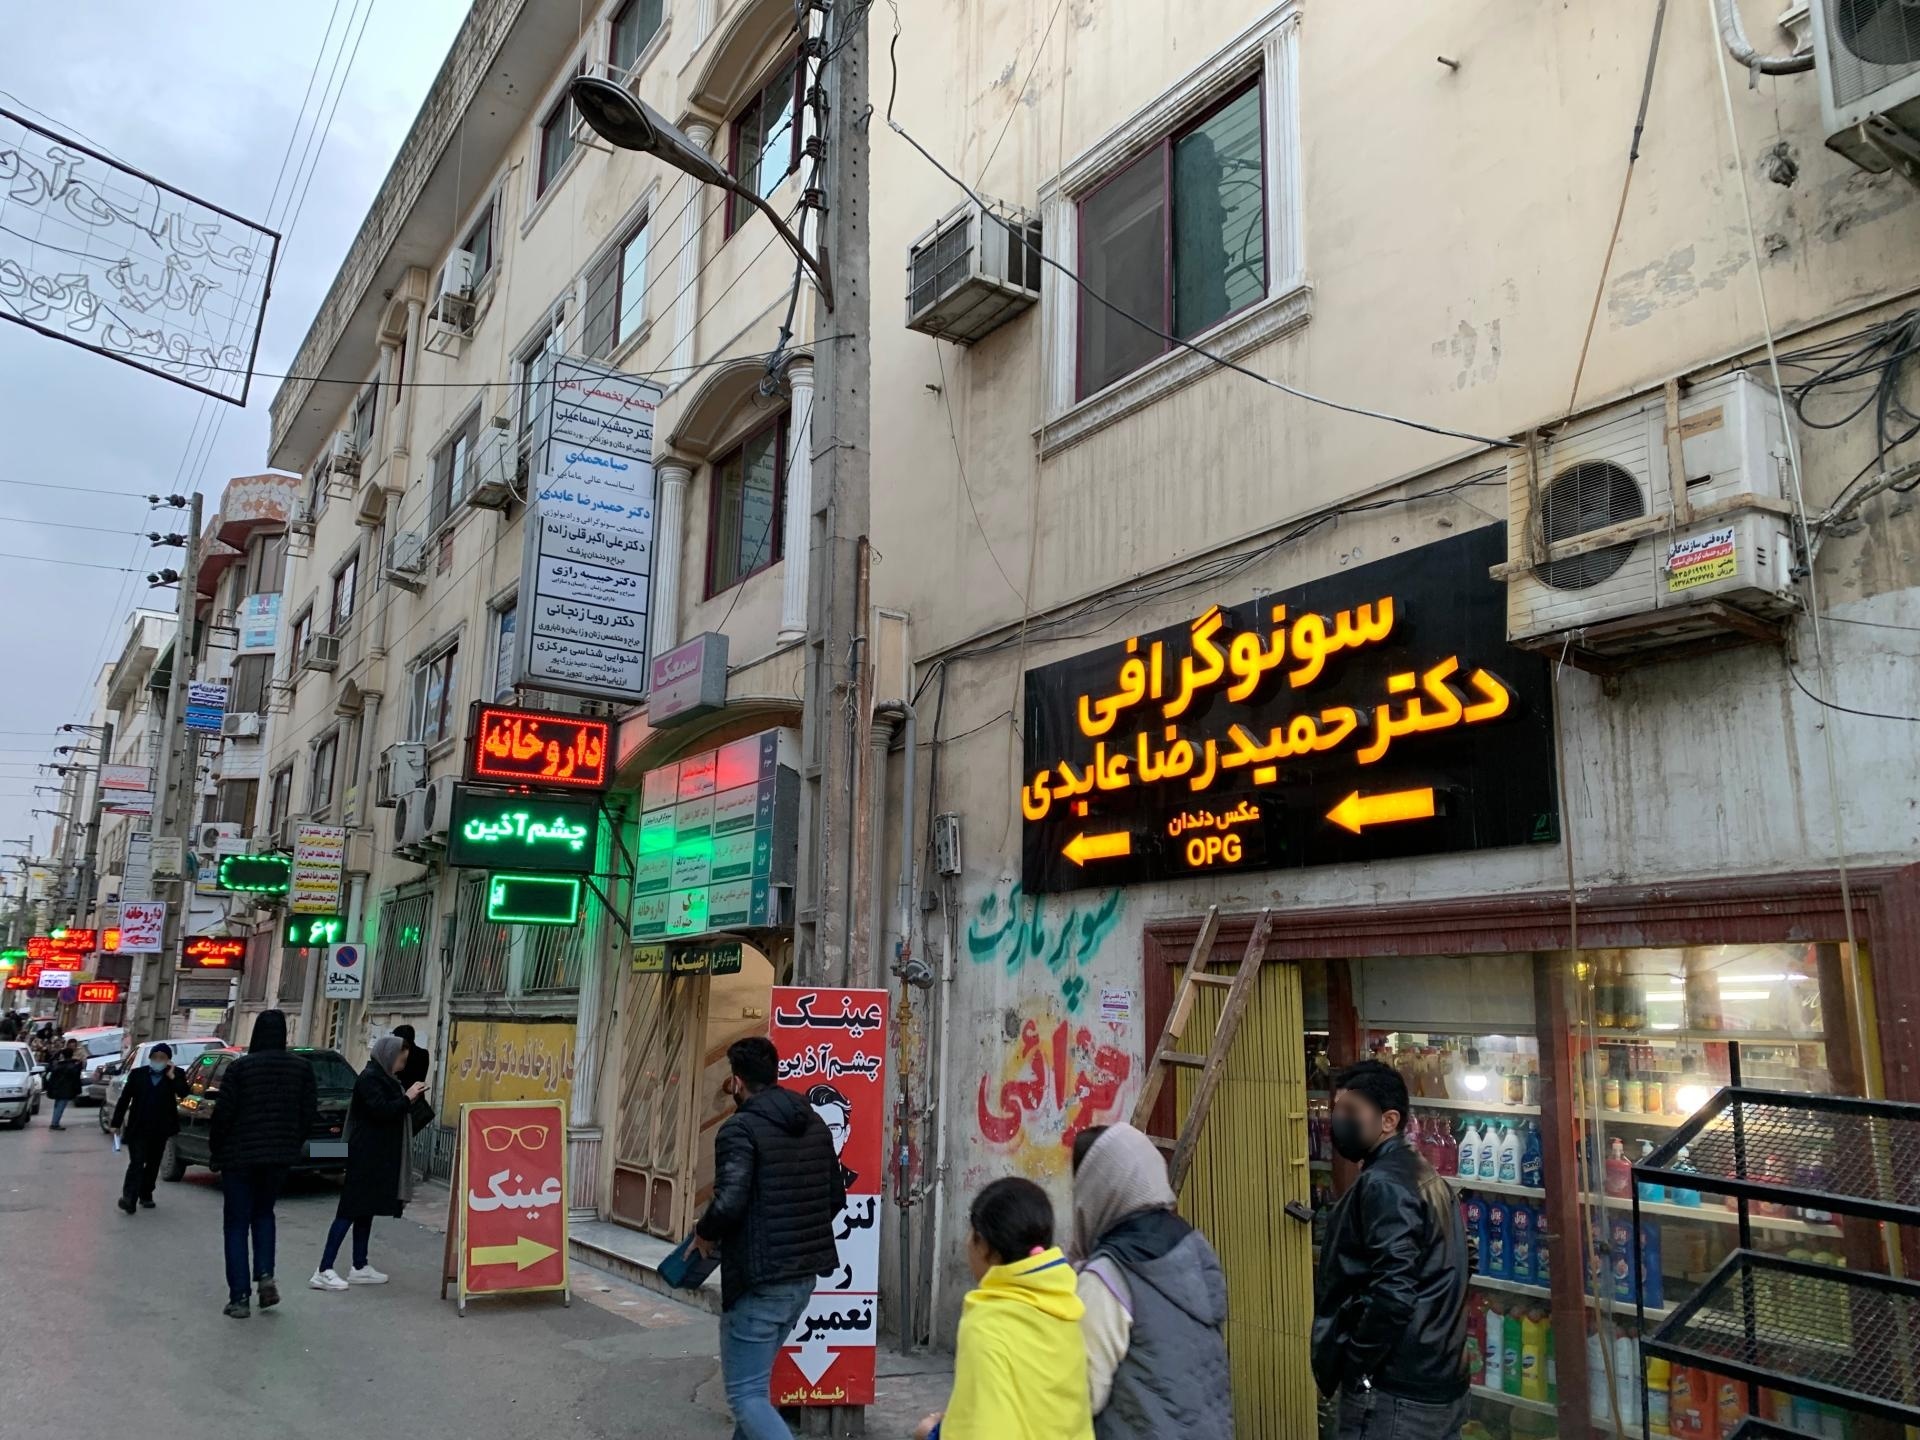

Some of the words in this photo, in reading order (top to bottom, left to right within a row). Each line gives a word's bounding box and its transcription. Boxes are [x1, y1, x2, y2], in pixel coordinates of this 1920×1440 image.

[555, 407, 600, 427] اسماعیلی
[601, 417, 634, 438] جمشید
[565, 450, 612, 467] محمدی
[539, 487, 574, 503] عابدی
[626, 506, 651, 519] دکتر
[547, 522, 568, 539] زاده
[568, 525, 587, 541] قلی
[587, 531, 606, 546] اکبر
[1716, 529, 1733, 544] گروه
[605, 534, 623, 549] علی
[622, 539, 646, 552] دکتر
[1702, 534, 1717, 549] فنی
[611, 556, 626, 567] جراح
[551, 565, 579, 579] رازی
[614, 574, 637, 588] دکتر
[547, 603, 587, 621] زنجانی
[585, 607, 610, 626] رویا
[611, 615, 636, 628] دکتر
[536, 641, 569, 655] مرکزی
[569, 646, 604, 659] شناسی
[627, 638, 641, 648] جراح
[604, 653, 640, 665] شنوایی
[1077, 594, 1395, 738] سونوگرافی
[656, 655, 698, 687] سمعک
[1355, 655, 1512, 765] دکتر
[485, 718, 602, 777] داروخانه
[1021, 742, 1131, 822] عابدی
[1166, 808, 1214, 838] دندان
[1214, 802, 1261, 825] عکس
[464, 811, 530, 841] آذین
[527, 815, 588, 851] چشم
[1186, 832, 1242, 868] OPG
[125, 905, 162, 924] داروخانه
[146, 923, 160, 934] دکتر
[967, 882, 1045, 967] مارکت
[186, 940, 219, 955] پزشکی
[220, 943, 242, 956] چشم
[1047, 886, 1122, 1013] سوپر
[634, 948, 664, 967] داروخانه
[674, 952, 705, 974] عینک
[775, 994, 882, 1038] عینک
[494, 1040, 517, 1083] دکتر
[518, 1037, 575, 1092] داروخانه
[777, 1042, 834, 1080] آذین
[828, 1050, 882, 1083] چشم
[467, 1167, 562, 1220] عینک
[780, 1385, 808, 1405] پایین
[808, 1385, 846, 1401] طبقه
